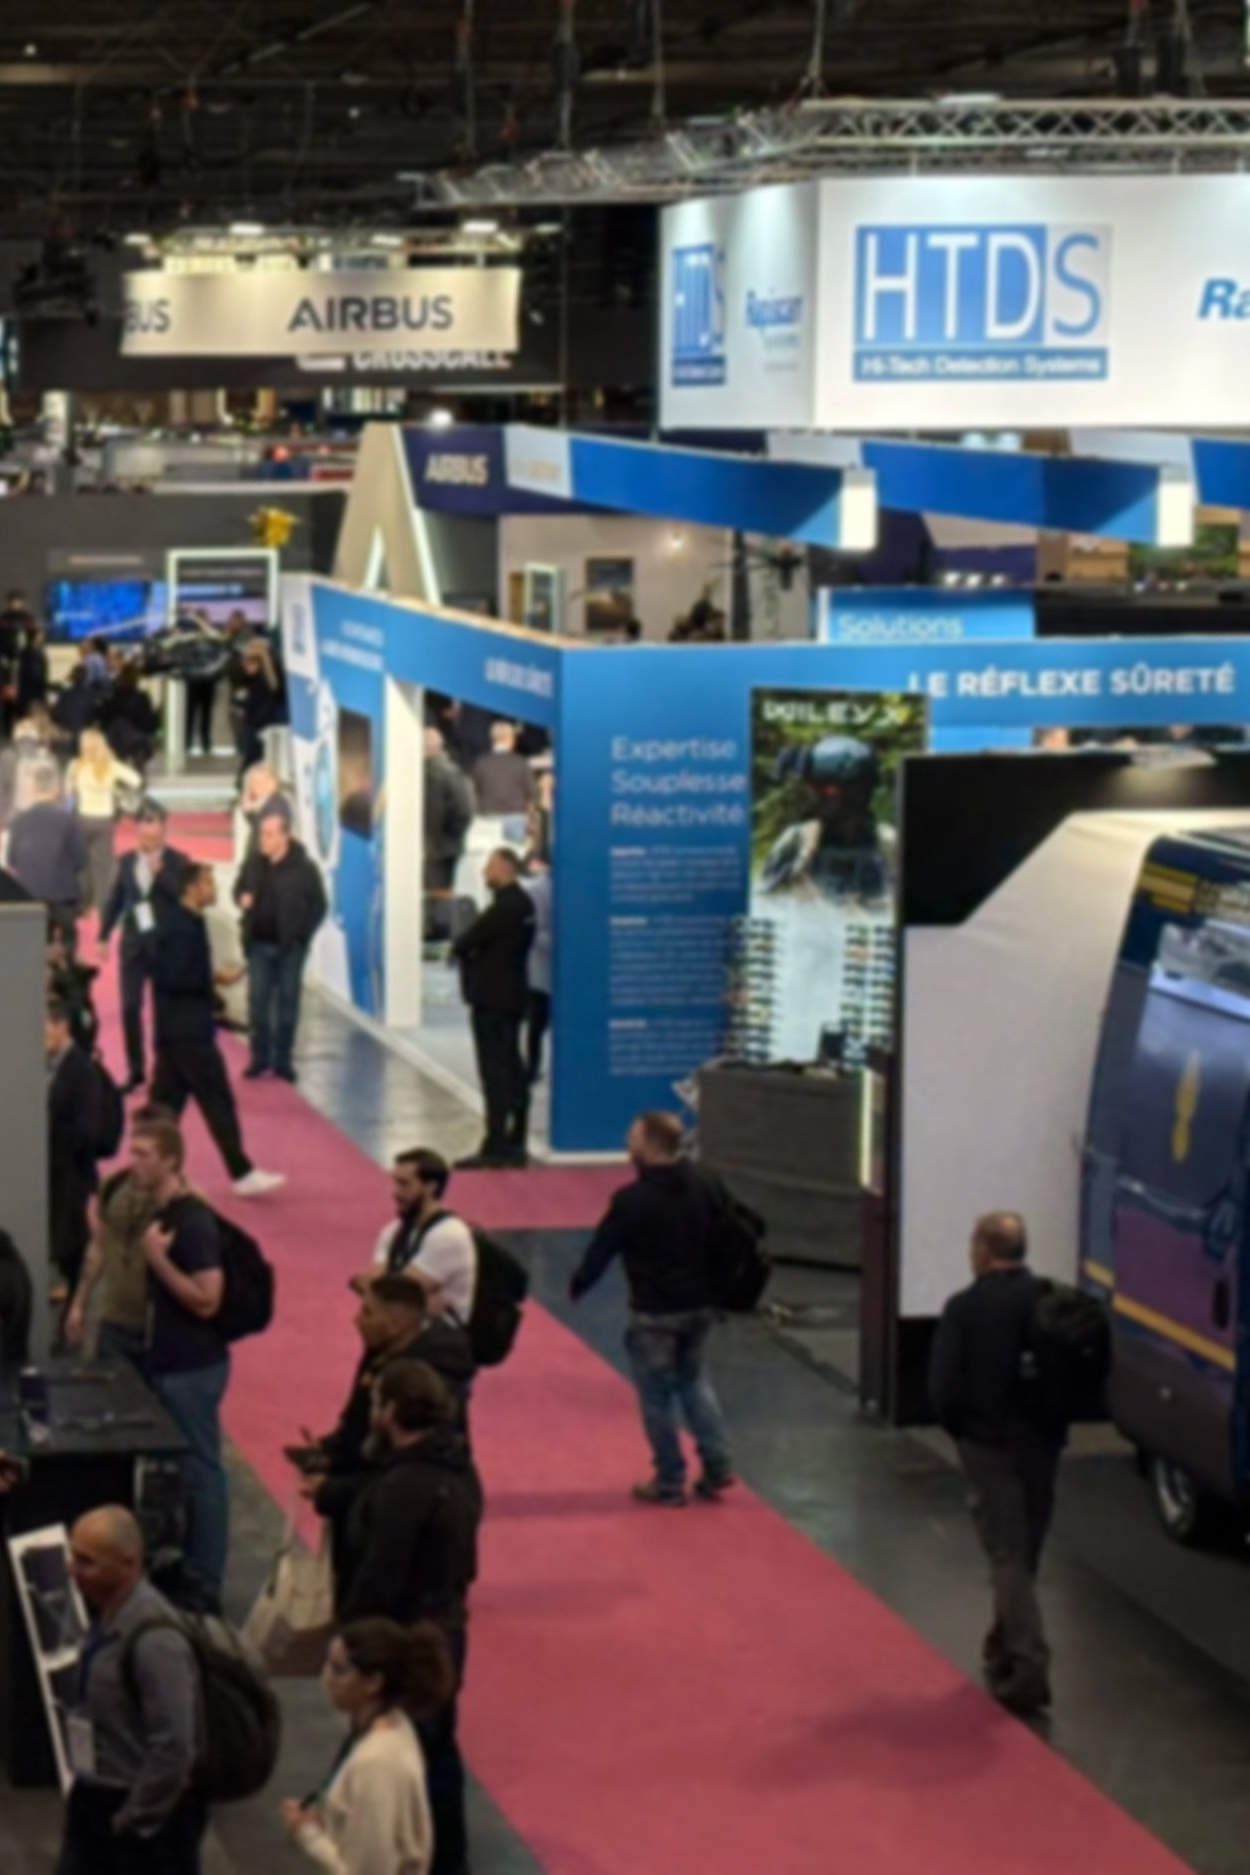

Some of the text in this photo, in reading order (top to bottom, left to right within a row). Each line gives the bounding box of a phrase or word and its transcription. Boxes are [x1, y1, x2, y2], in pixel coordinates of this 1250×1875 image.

[863, 232, 1103, 342] HTDS
[287, 296, 453, 333] AIRBUS
[935, 355, 1019, 375] Detection
[1025, 355, 1100, 378] Systems
[837, 612, 964, 640] Solutions
[956, 664, 1103, 697] RÉFLEXE
[1110, 661, 1237, 695] SÛRETÉ
[611, 735, 738, 763] Expertise
[611, 769, 747, 796] Souplesse
[611, 802, 746, 827] Réactivité
